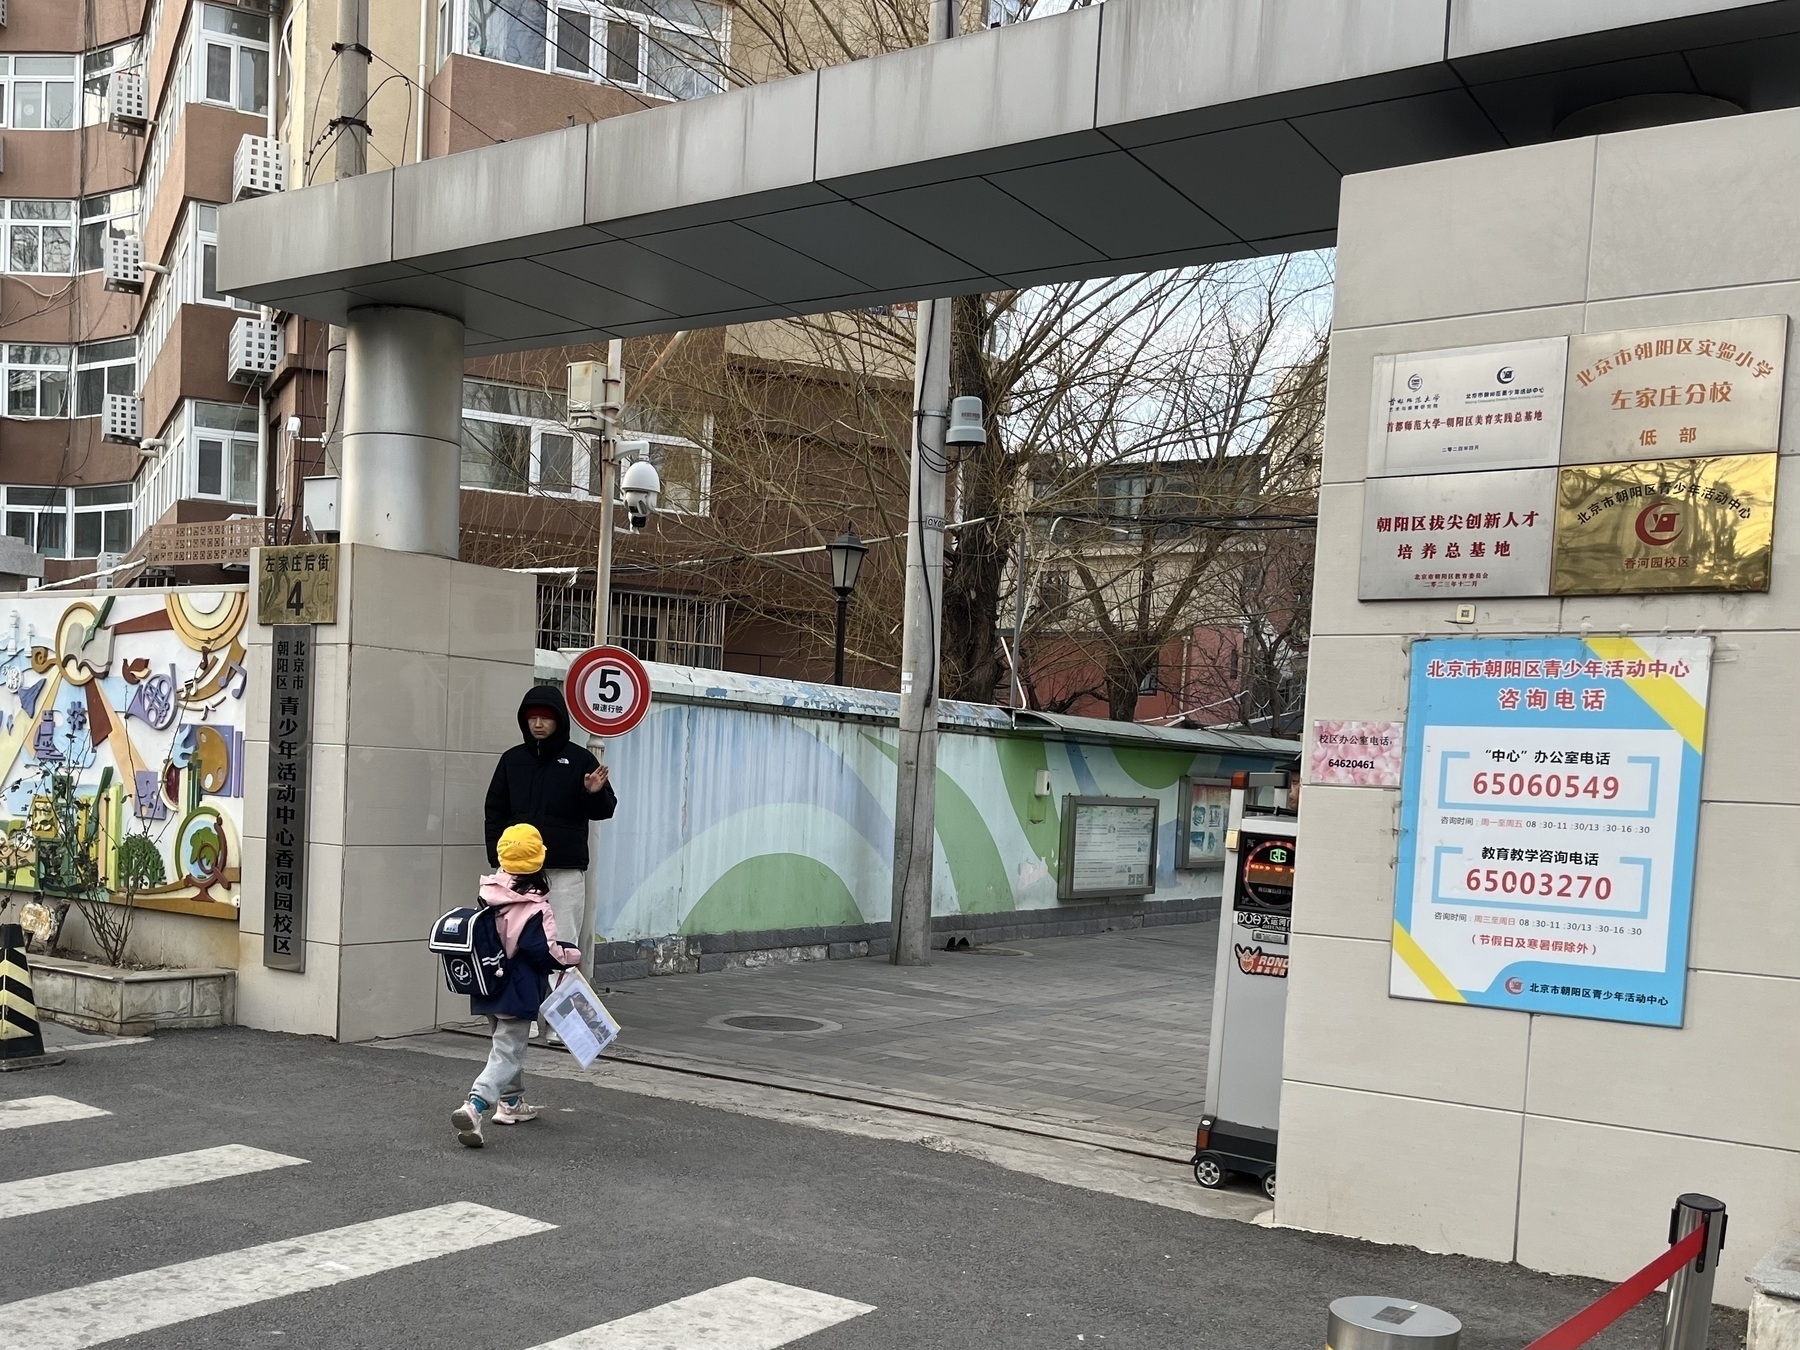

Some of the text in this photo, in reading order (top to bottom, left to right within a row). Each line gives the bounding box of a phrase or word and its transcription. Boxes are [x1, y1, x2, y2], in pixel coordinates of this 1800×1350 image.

[1575, 338, 1774, 389] 北京市朝阳区实验小学
[1611, 380, 1733, 411] 左家庄分校
[1576, 481, 1752, 526] 北京市朝阳区青少年活动中心
[1376, 510, 1539, 533] 朝阳区拔尖创新人才
[1397, 540, 1511, 560] 培养总基地
[265, 553, 329, 573] 左家庄后街
[1624, 556, 1690, 570] 香河园校区
[1414, 572, 1489, 580] 北京市朝阳区教育委员会
[1423, 580, 1478, 588] 二零二三年十二月
[286, 580, 304, 616] 4
[276, 640, 289, 690] 朝阳区
[292, 640, 306, 690] 北京市
[1427, 659, 1690, 679] 北京市朝阳区青少年活动中心
[598, 668, 621, 703] 5
[592, 703, 624, 714] 限速行驶
[1498, 688, 1606, 711] 咨询电话
[1328, 758, 1375, 769] 64620461
[1472, 771, 1620, 800] 65060549
[272, 696, 300, 956] 青少年活动中心香河园校区
[1481, 846, 1599, 867] 教育教学咨询电话
[1466, 868, 1612, 901] 65003270
[1529, 982, 1669, 1007] 北京市朝阳区青少年活动中心
